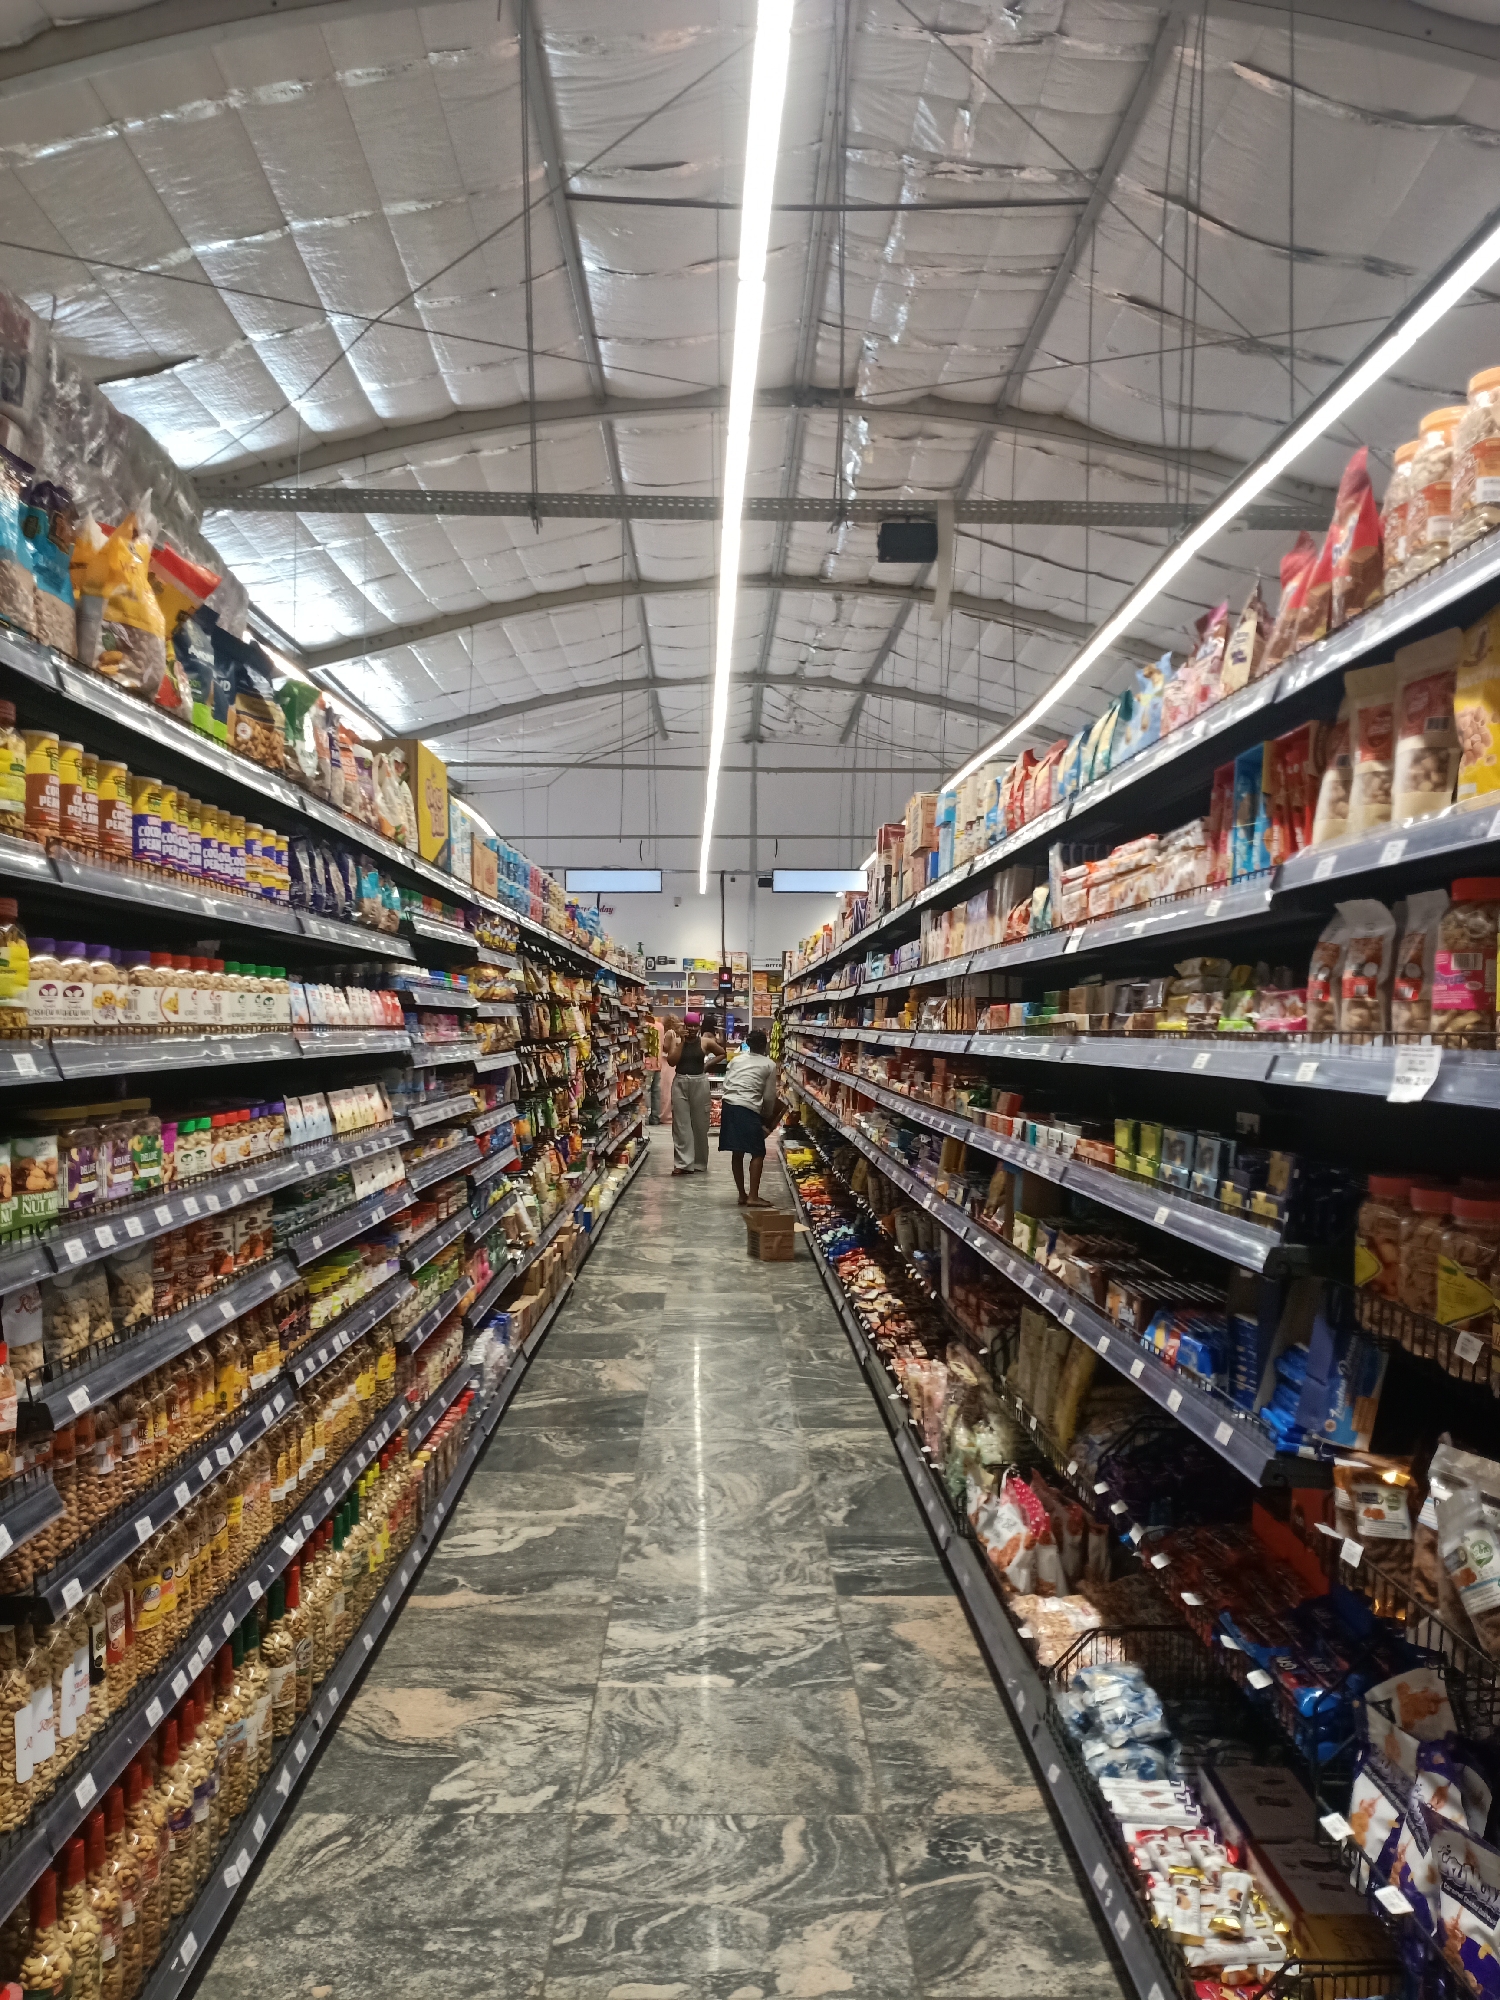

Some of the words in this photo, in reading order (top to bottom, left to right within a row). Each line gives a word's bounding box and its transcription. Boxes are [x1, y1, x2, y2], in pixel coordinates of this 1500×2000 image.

[28, 1008, 54, 1017] CASHEW
[113, 1155, 131, 1167] DELUXE
[140, 1151, 158, 1163] DELUXE
[80, 1163, 96, 1176] DELUXE
[22, 1193, 43, 1202] HONEY
[22, 1199, 47, 1215] NUT
